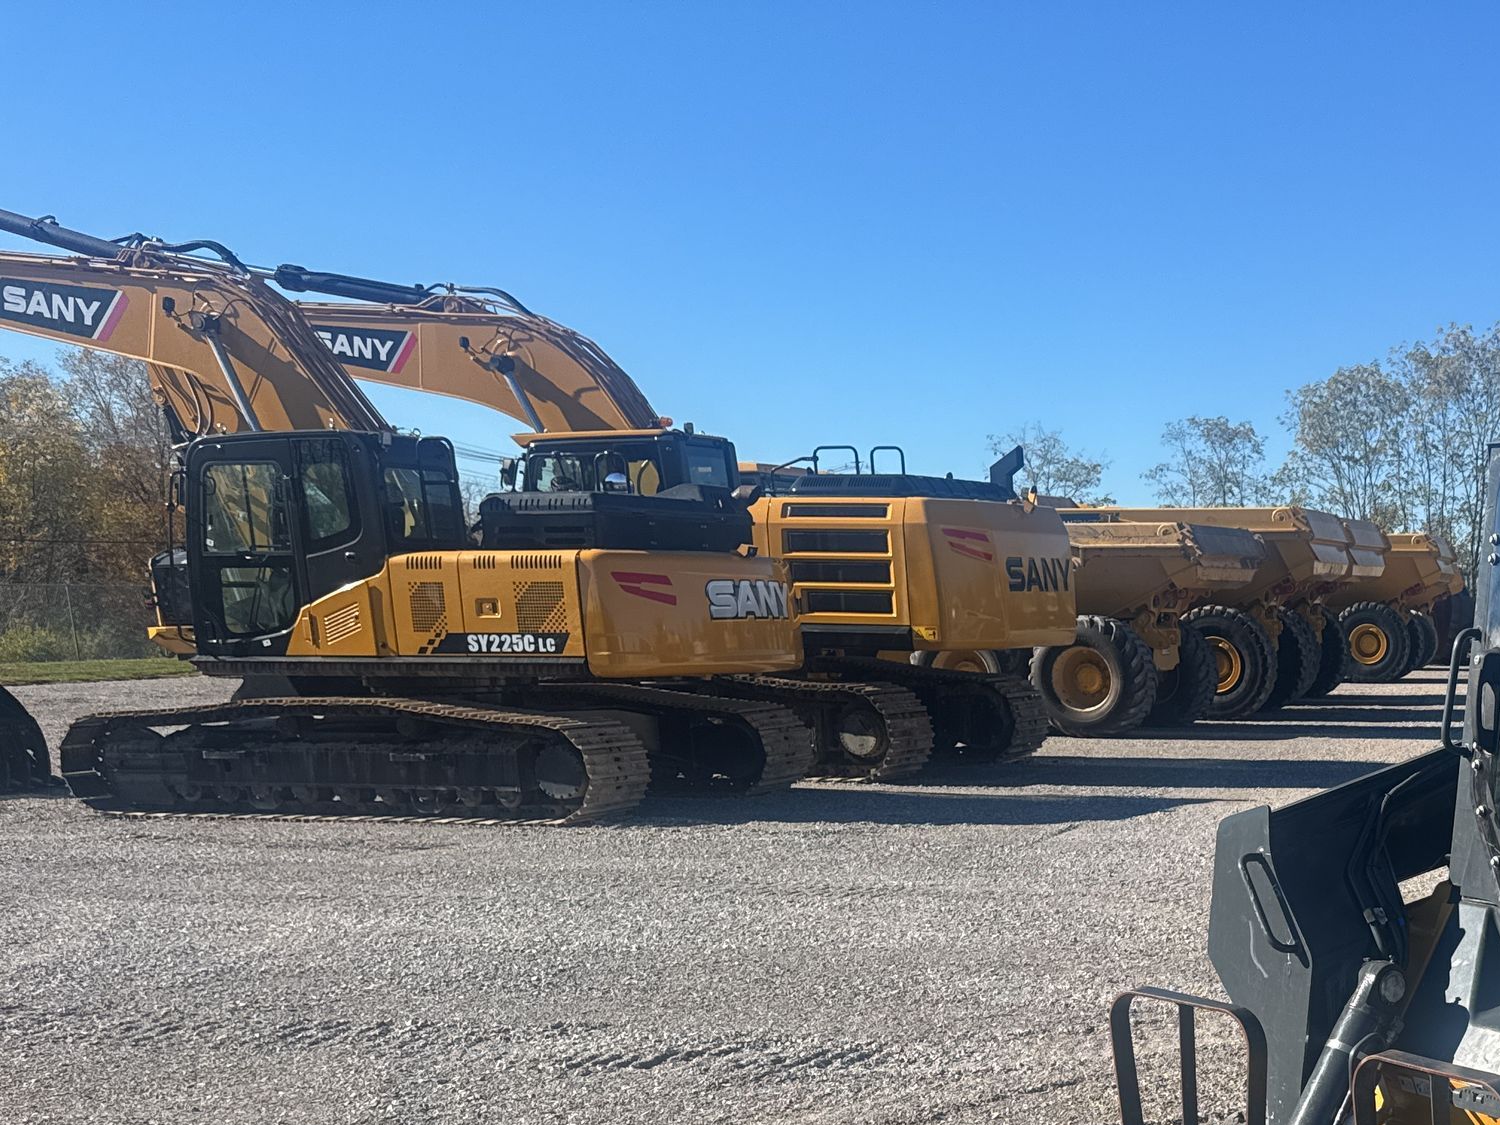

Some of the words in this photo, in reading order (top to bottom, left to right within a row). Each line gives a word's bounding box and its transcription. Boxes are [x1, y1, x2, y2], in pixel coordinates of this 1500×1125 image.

[2, 285, 101, 326] SANY
[1005, 556, 1070, 592] SANY
[705, 579, 789, 620] SANY
[467, 634, 535, 652] SY225C
[538, 638, 556, 652] LC
